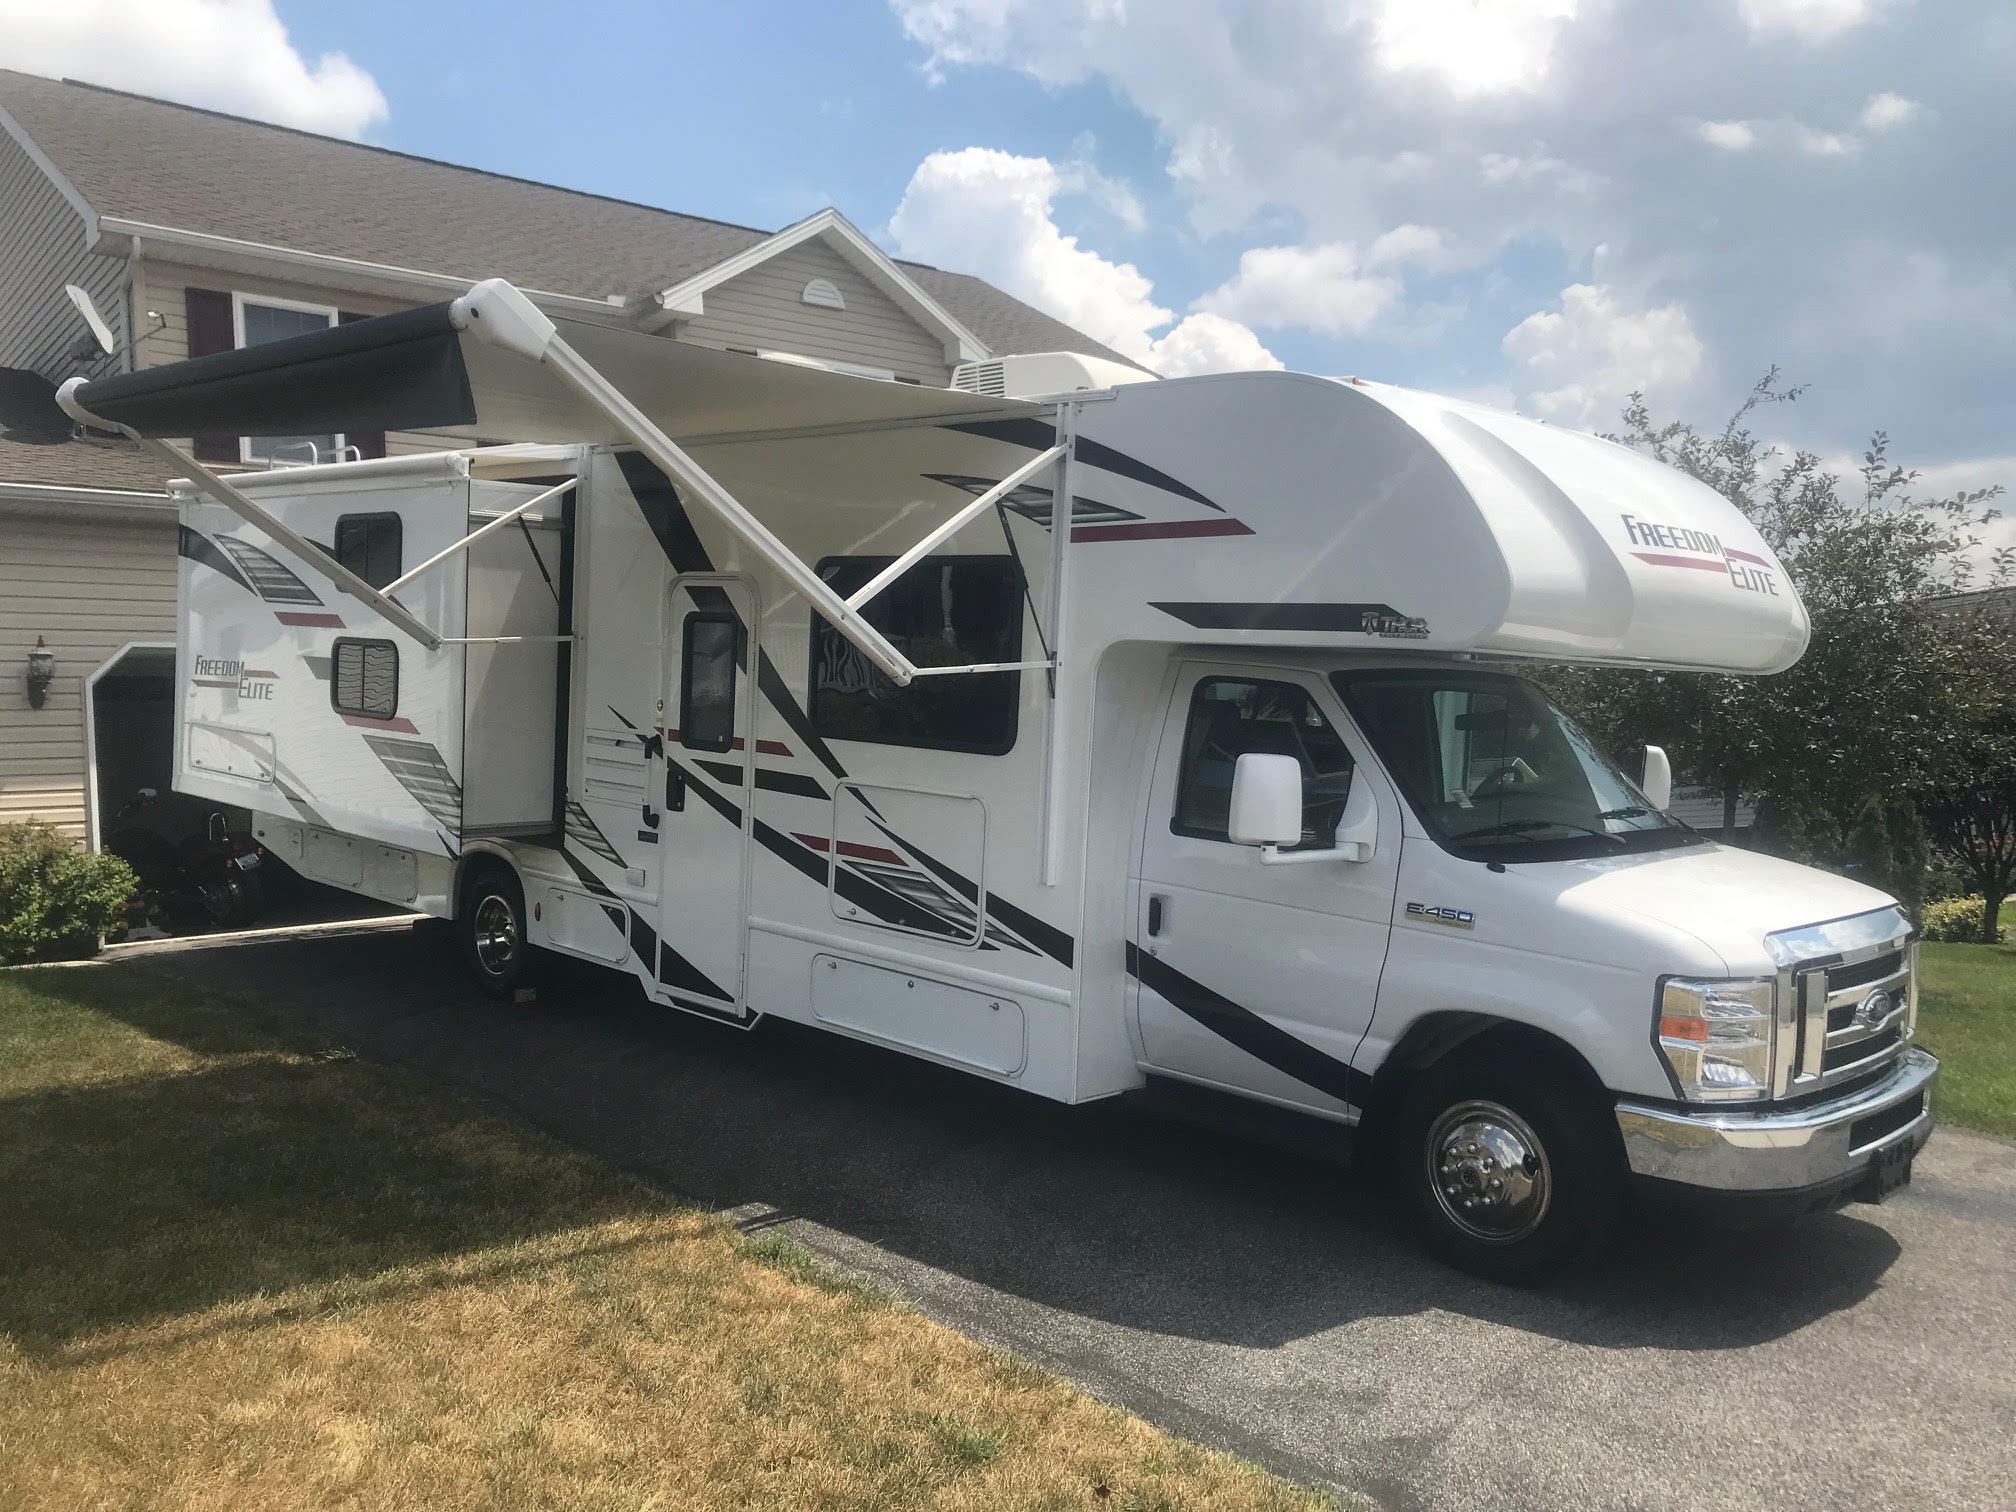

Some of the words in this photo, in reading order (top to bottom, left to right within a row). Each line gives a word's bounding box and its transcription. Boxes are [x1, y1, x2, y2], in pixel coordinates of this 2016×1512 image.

[1621, 514, 1726, 556] FREEDOM
[1726, 559, 1779, 596] ELITE
[195, 655, 244, 676] FREEDOM
[239, 677, 273, 700] ELITE
